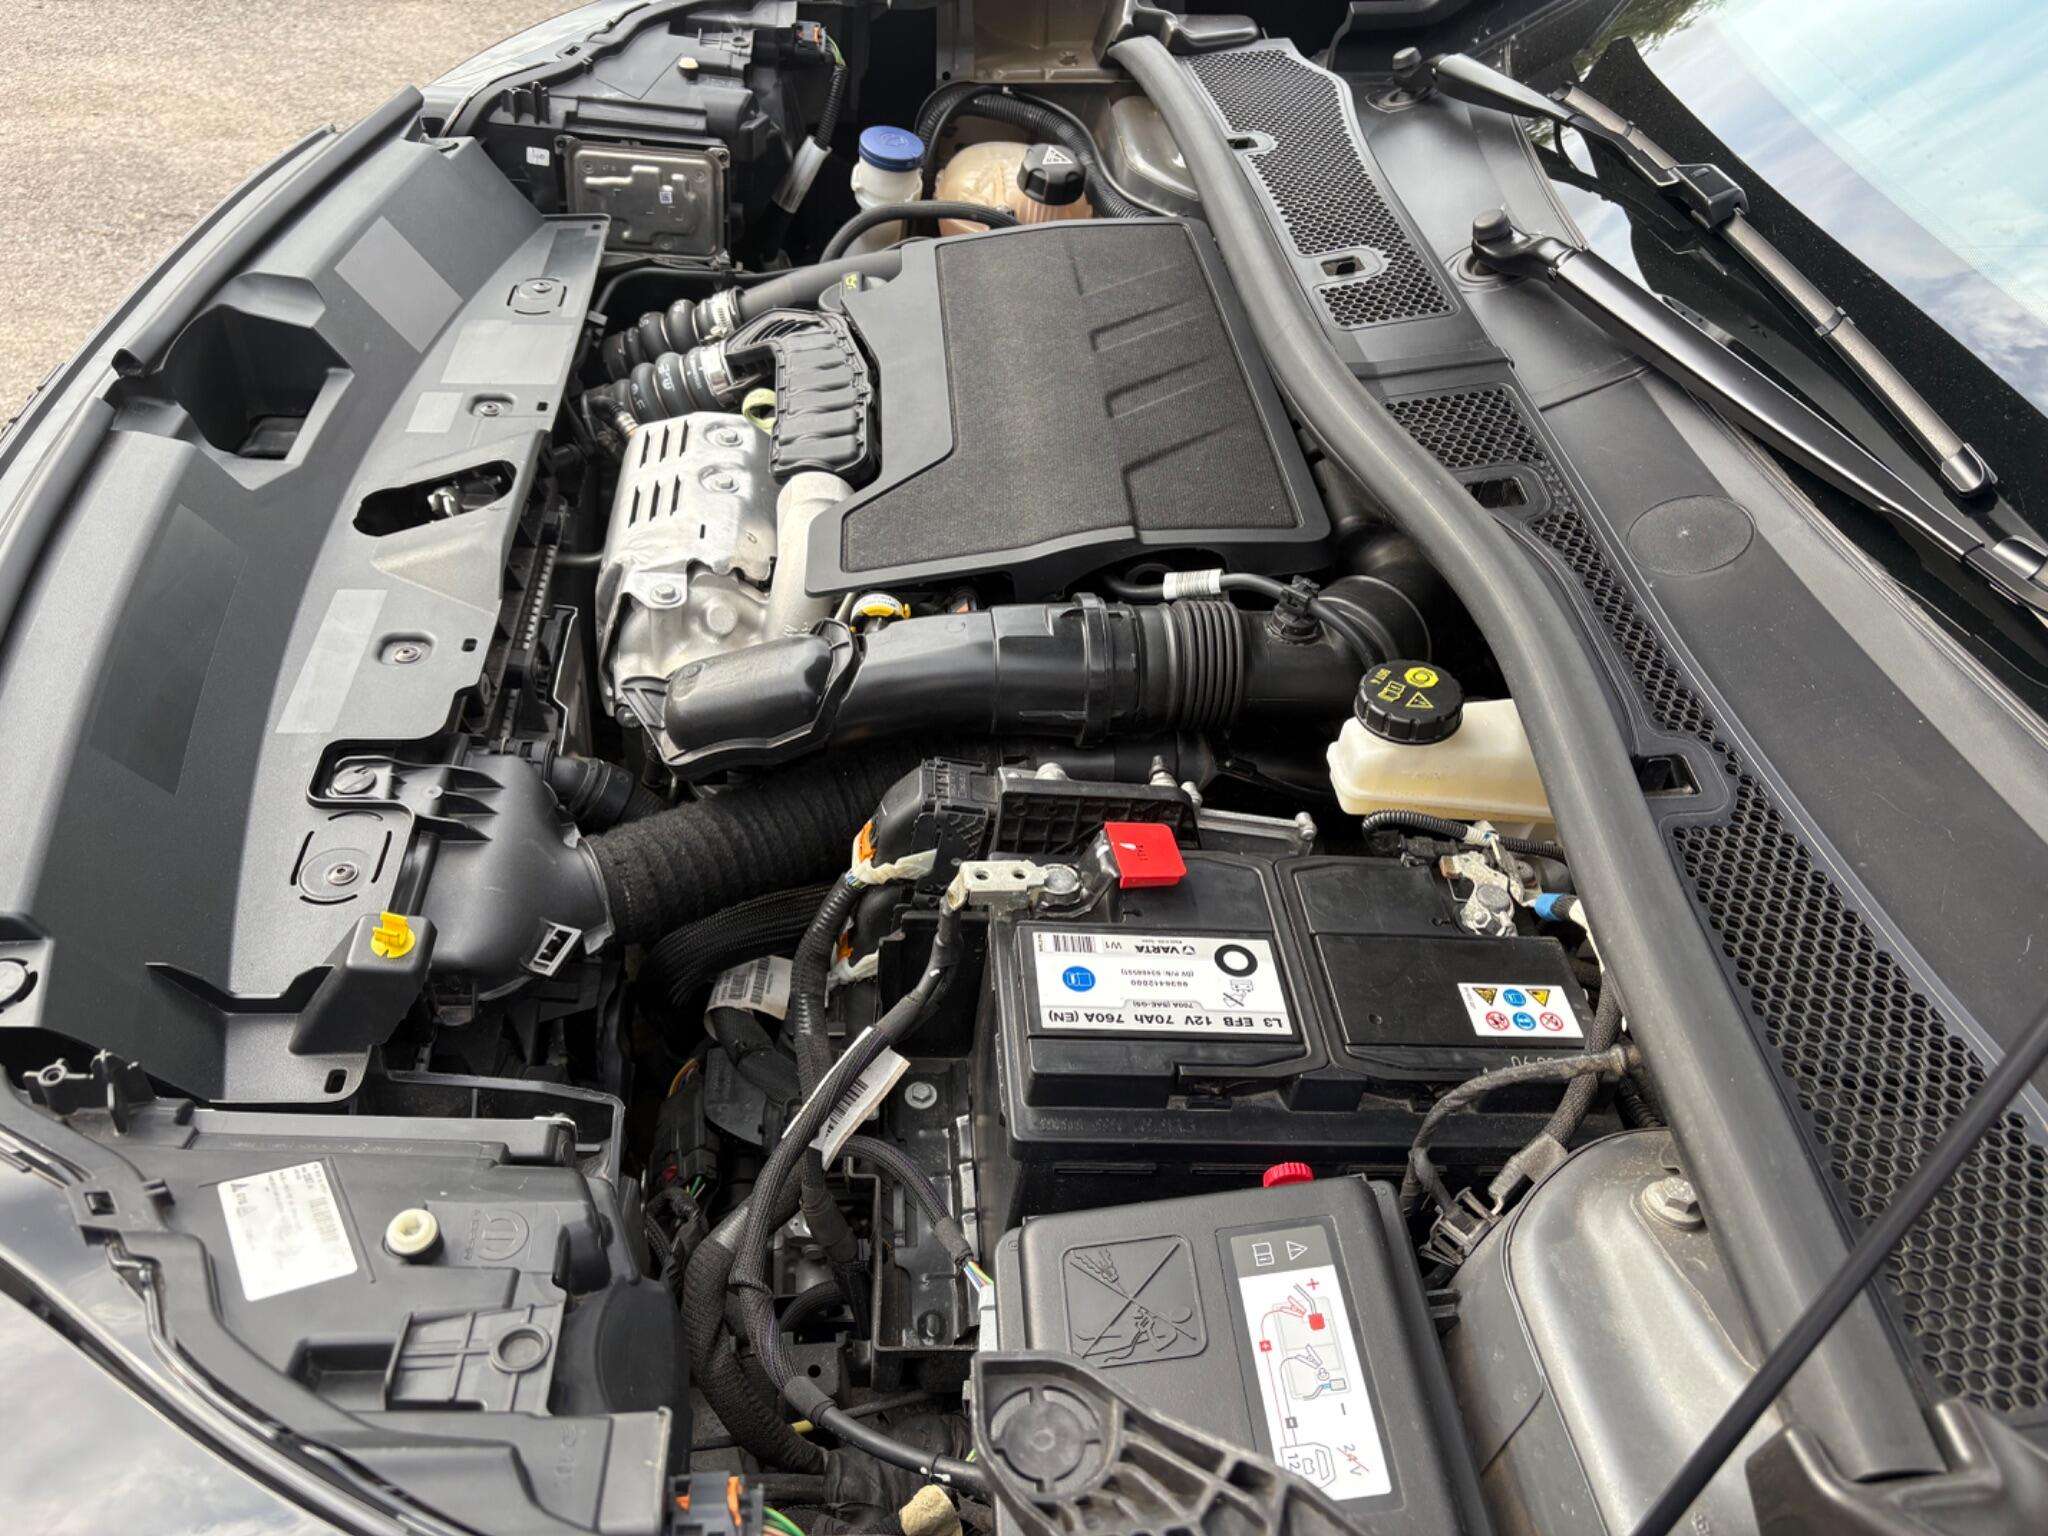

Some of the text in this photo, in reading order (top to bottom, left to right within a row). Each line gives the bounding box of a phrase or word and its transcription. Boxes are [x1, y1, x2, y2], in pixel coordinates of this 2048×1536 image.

[1134, 944, 1181, 955] VARTA
[1049, 1010, 1283, 1028] L3 EFB 12V 70Ah 760A (EN)
